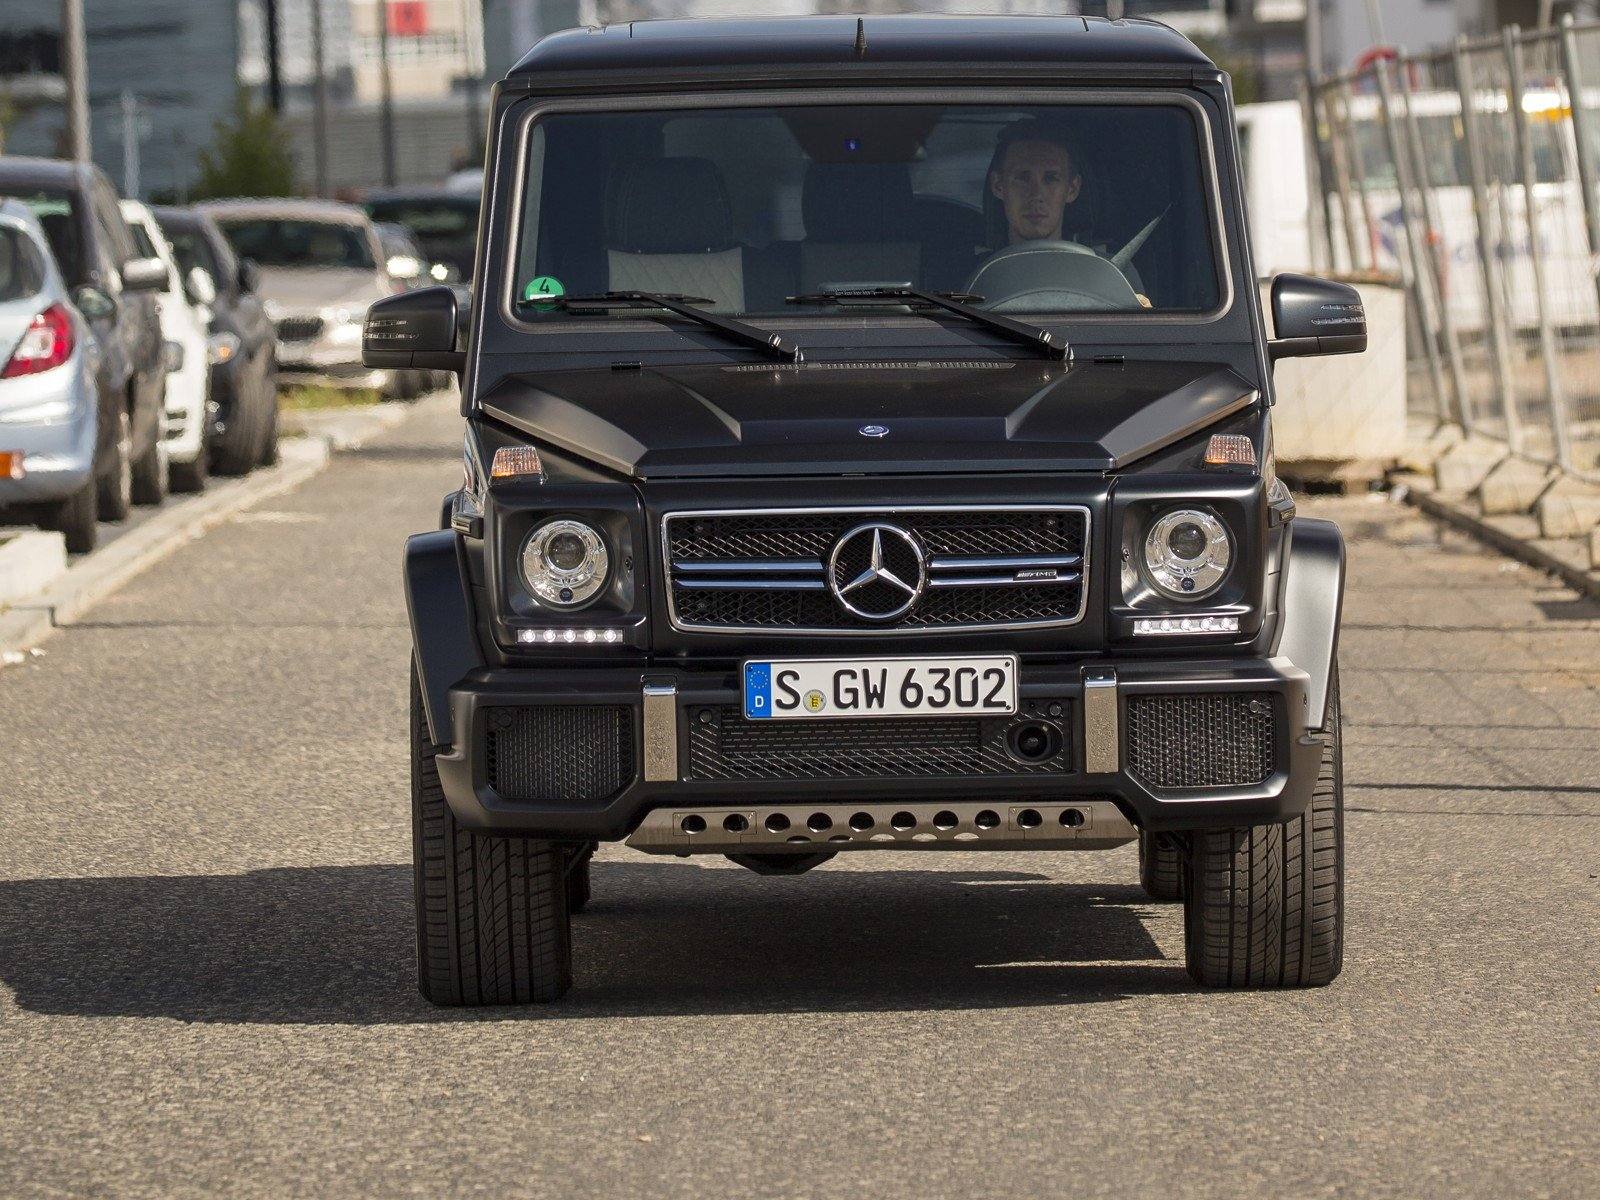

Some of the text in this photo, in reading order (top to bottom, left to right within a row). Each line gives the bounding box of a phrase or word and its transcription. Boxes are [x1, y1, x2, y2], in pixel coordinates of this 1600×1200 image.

[539, 278, 550, 294] 4
[775, 667, 1007, 710] S GW 6302
[754, 695, 765, 708] D
